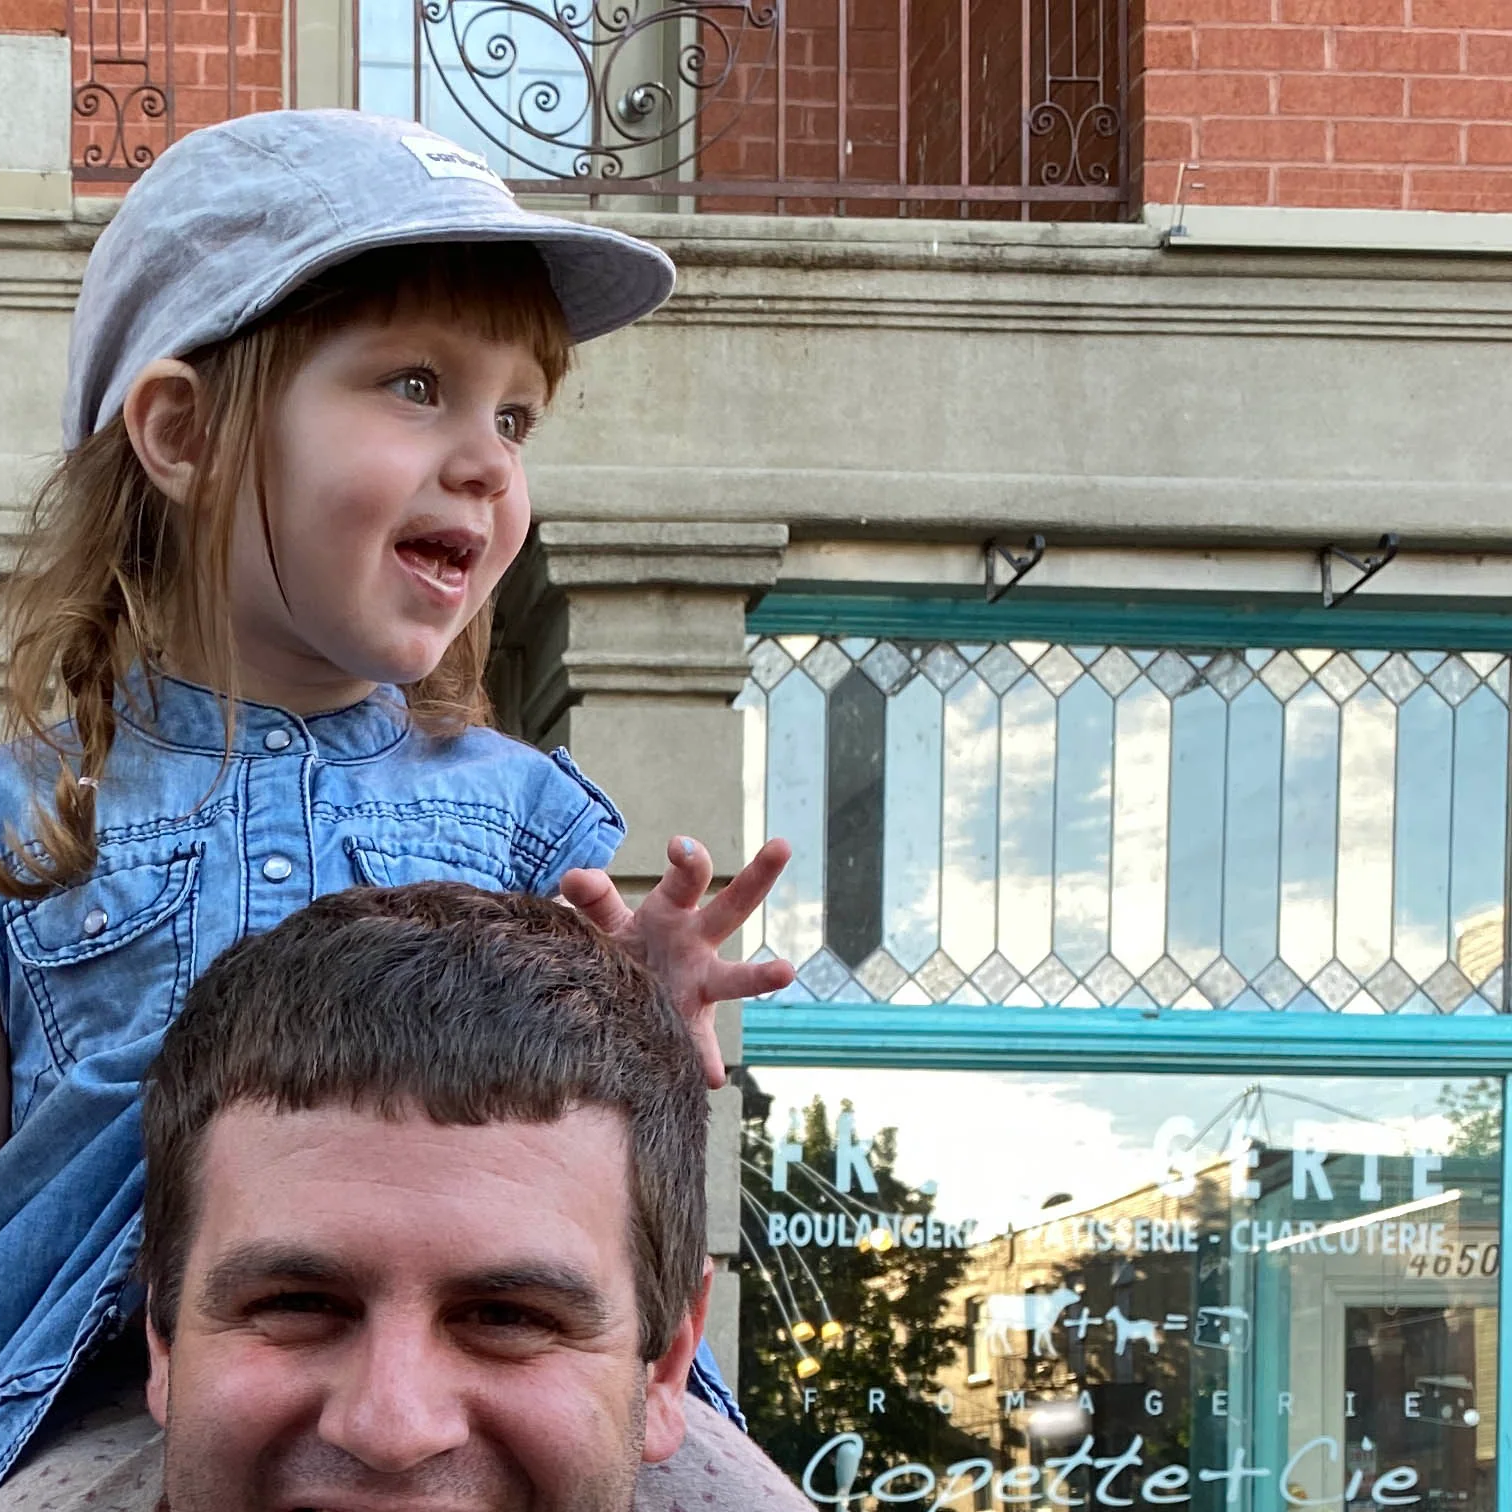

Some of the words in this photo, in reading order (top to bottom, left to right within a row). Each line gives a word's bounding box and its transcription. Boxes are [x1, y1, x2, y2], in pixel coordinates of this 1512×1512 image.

[1231, 1219, 1449, 1255] CHARCUTERIE
[1410, 1244, 1501, 1277] 4650
[803, 1387, 1421, 1417] FROMAGERIE
